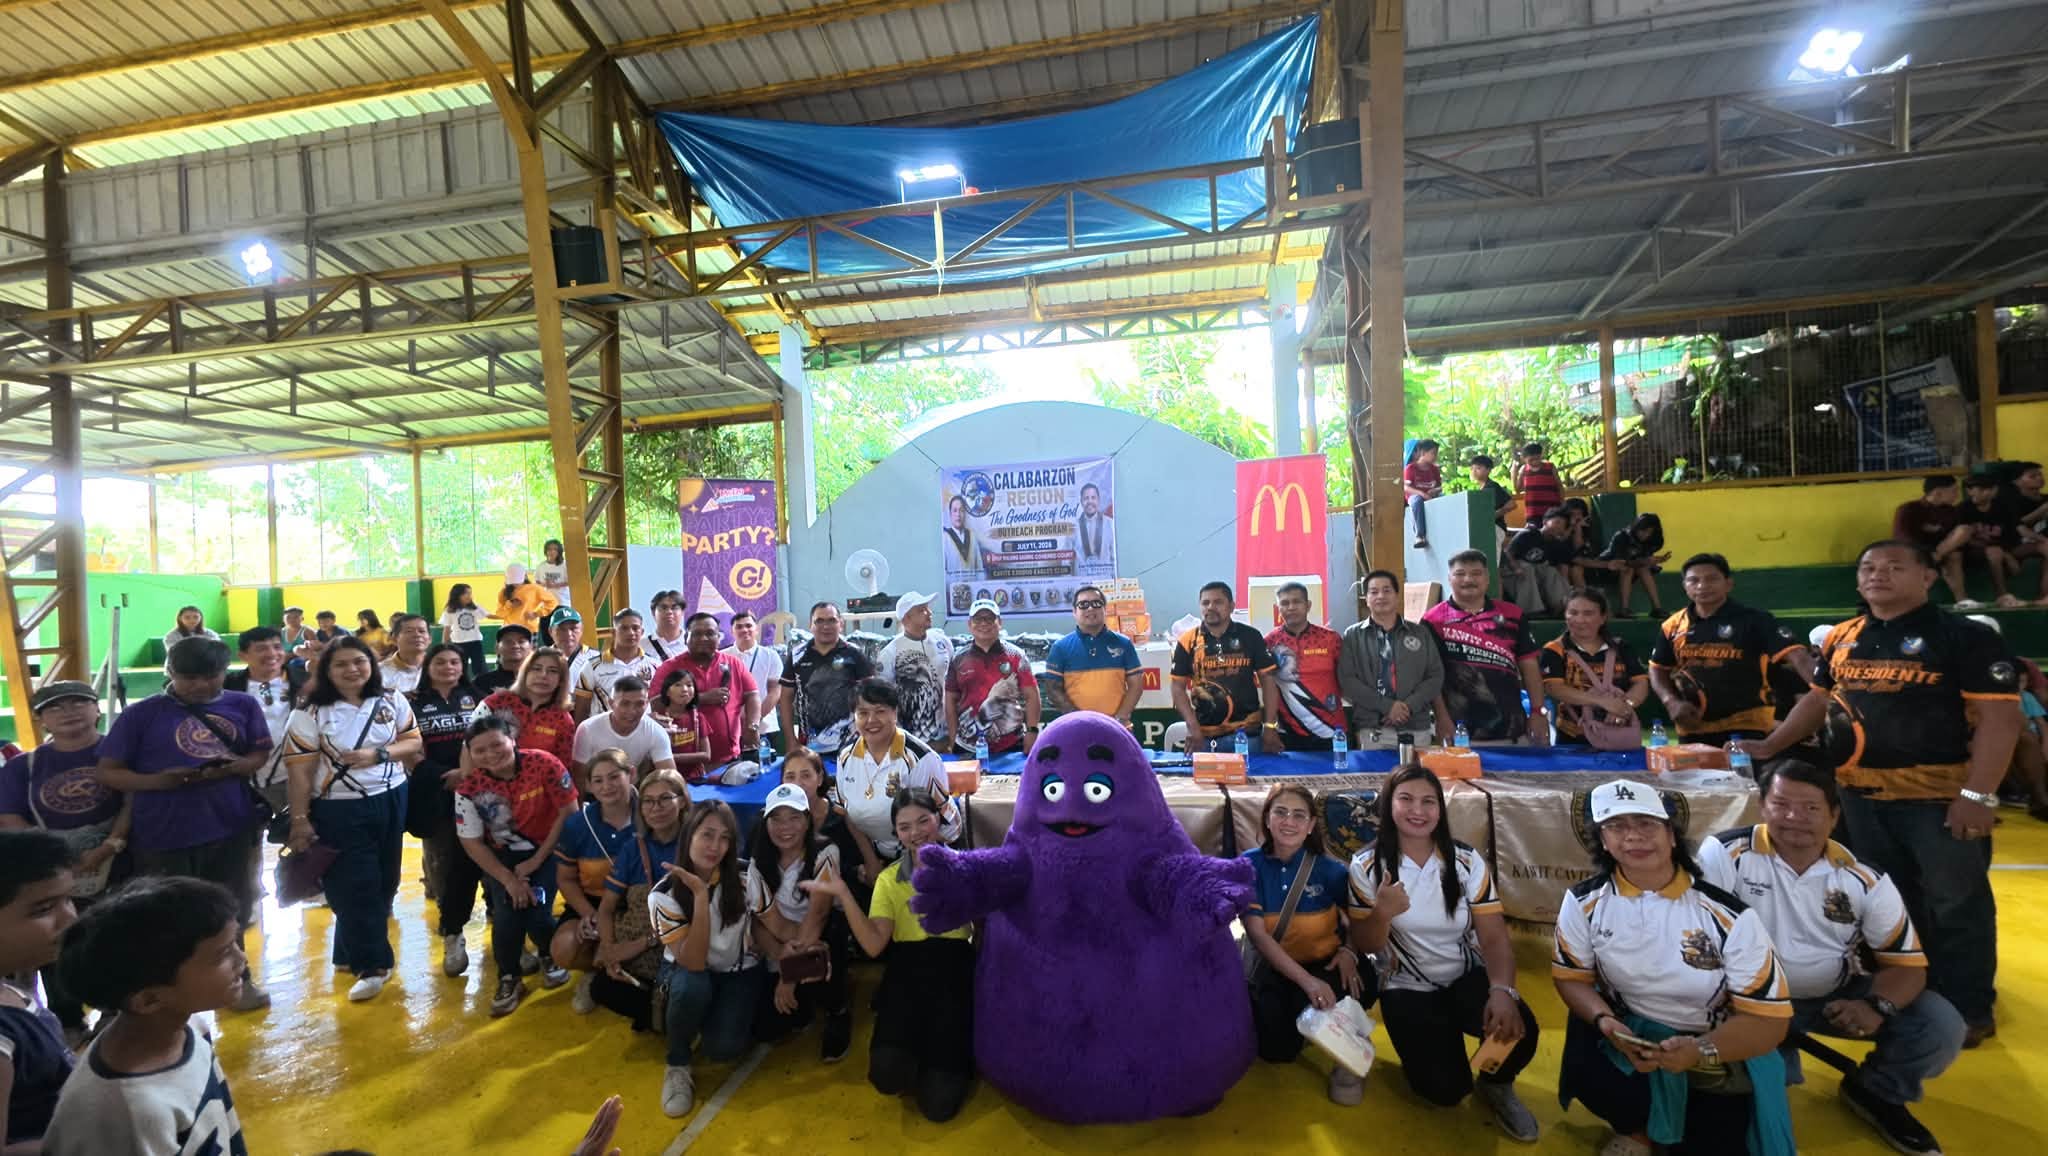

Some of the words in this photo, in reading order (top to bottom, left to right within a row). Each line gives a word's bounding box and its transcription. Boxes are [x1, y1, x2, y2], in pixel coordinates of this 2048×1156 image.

[993, 467, 1076, 490] CALABARZON
[1007, 488, 1065, 507] REGION
[989, 511, 1004, 527] The
[1006, 507, 1047, 524] Goodness
[1048, 507, 1058, 524] of
[1060, 503, 1080, 518] God
[997, 525, 1034, 537] OUTREACH
[1035, 523, 1068, 536] PROGRAM
[682, 525, 775, 555] PARTY?
[736, 565, 766, 588] G!
[1835, 666, 1945, 685] PRESIDENTE
[1615, 784, 1635, 801] LA
[1512, 865, 1550, 879] KAWIT
